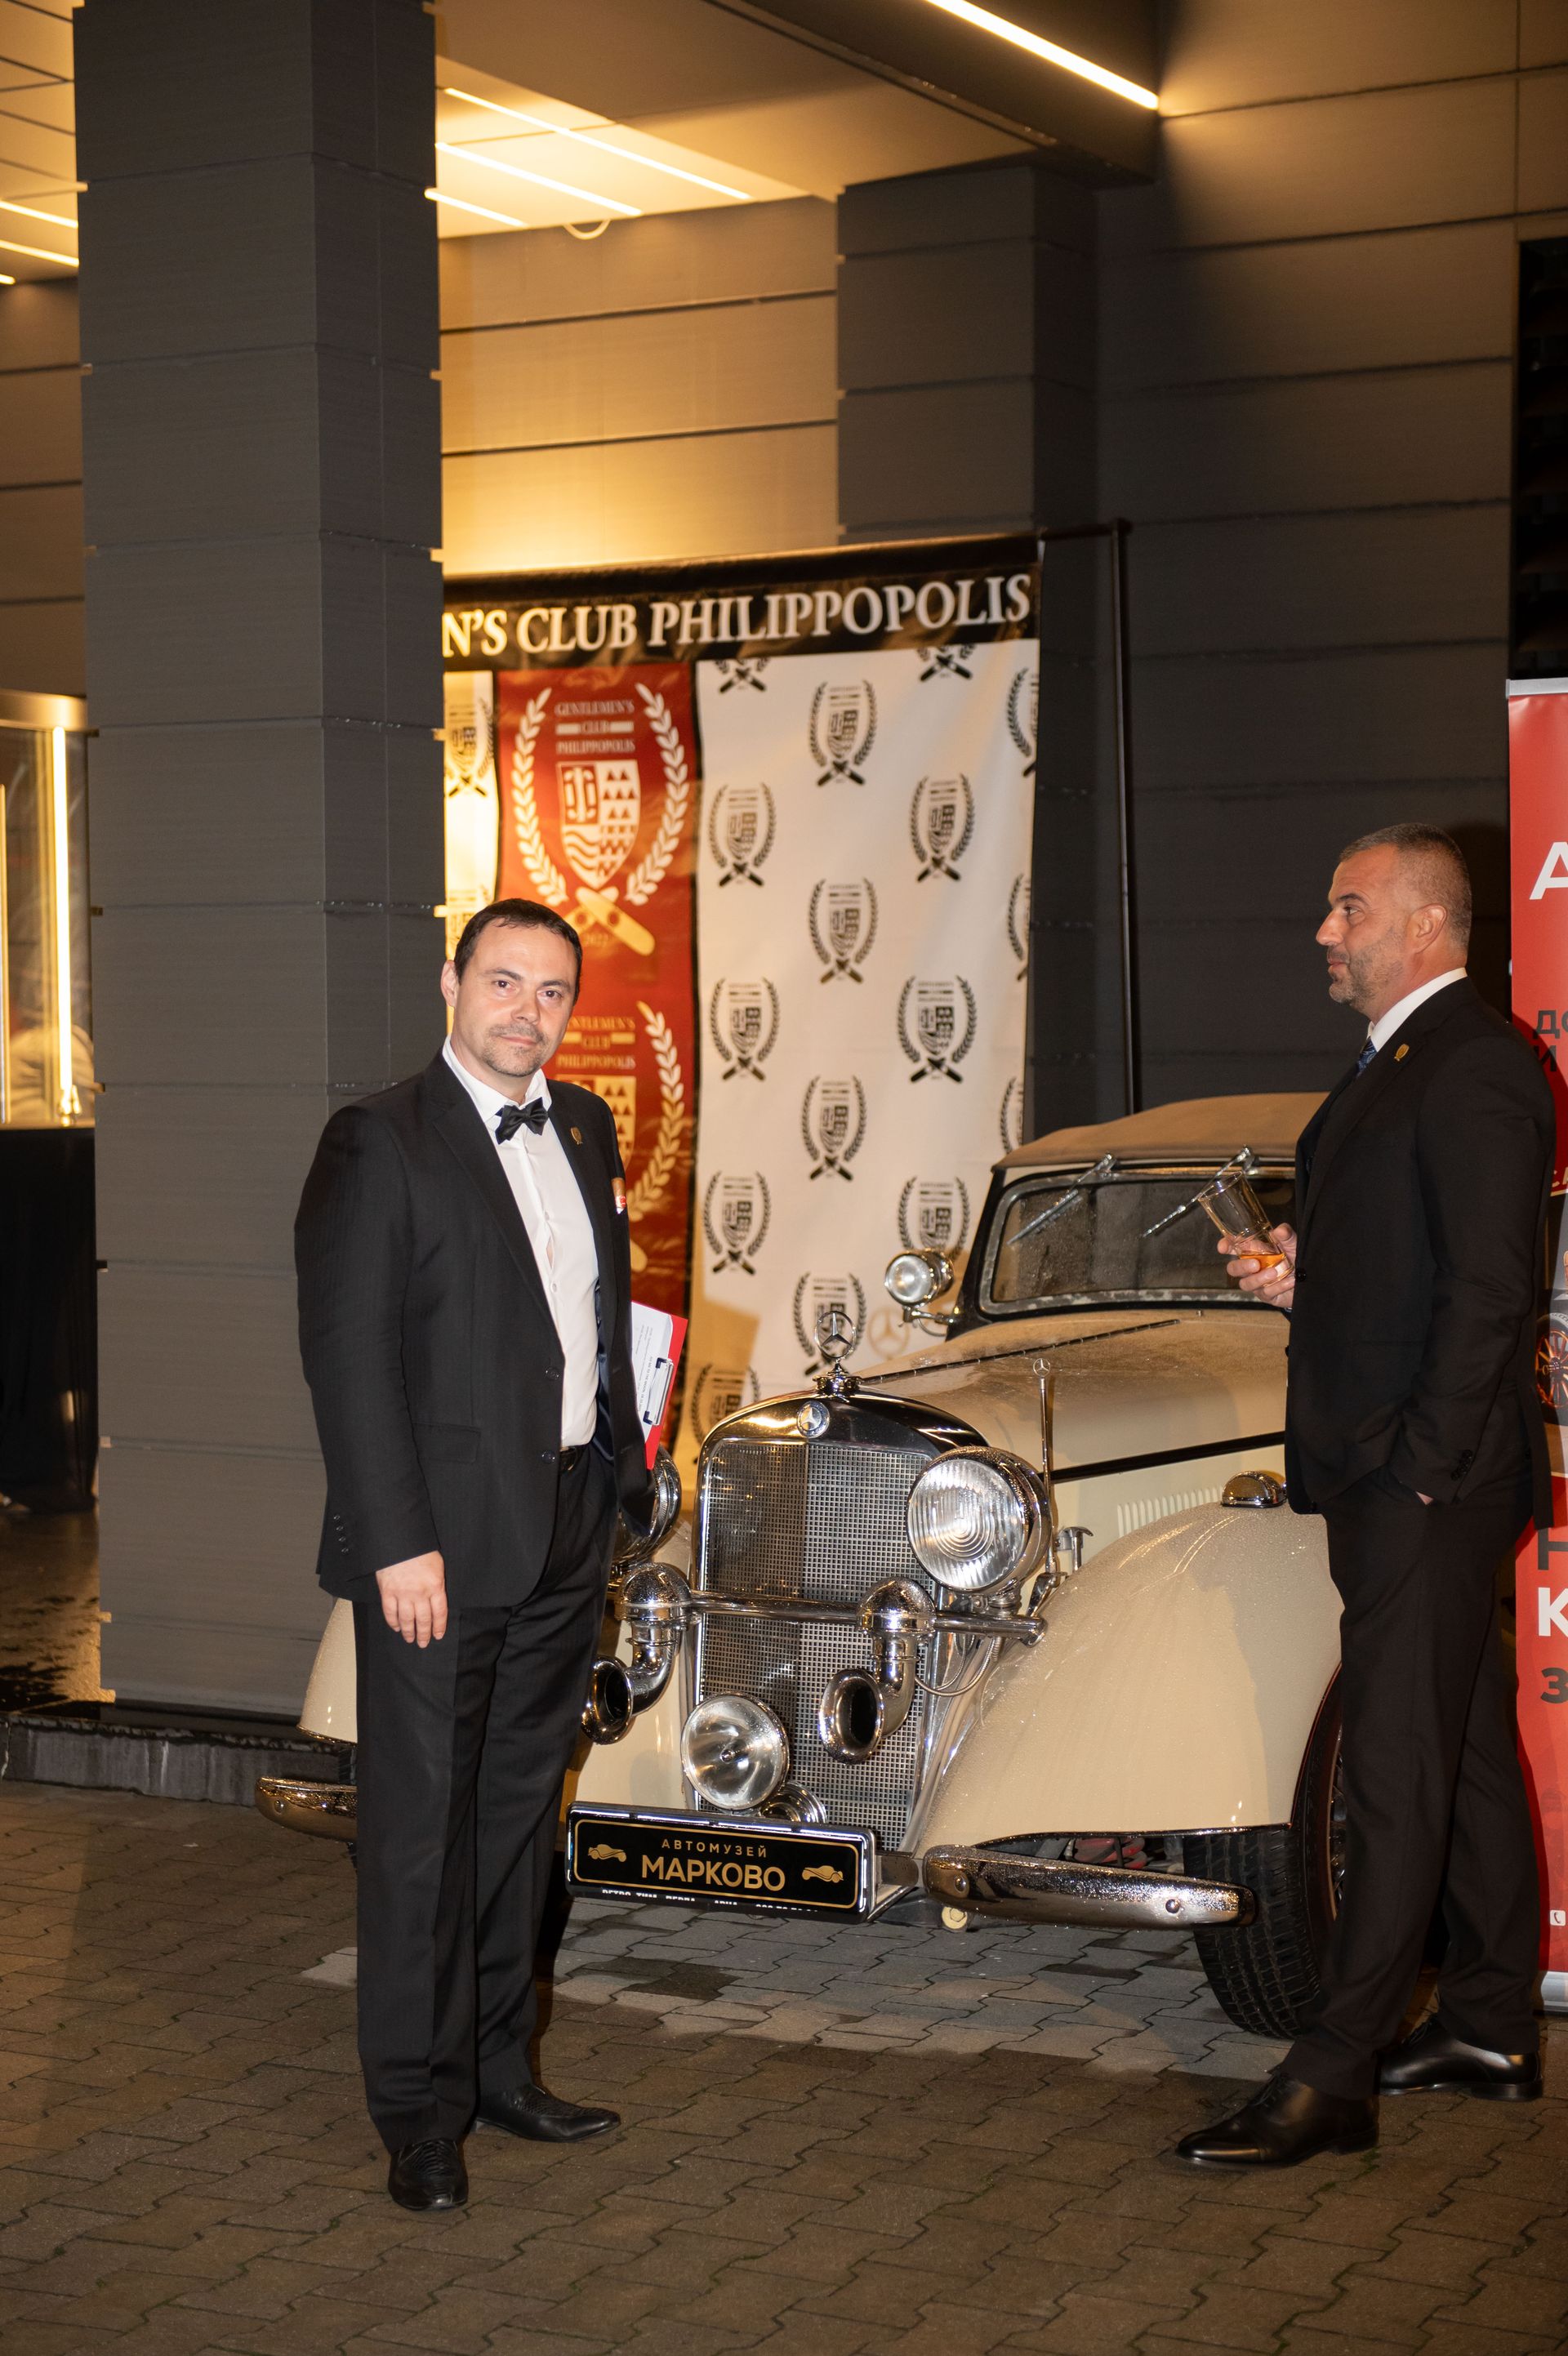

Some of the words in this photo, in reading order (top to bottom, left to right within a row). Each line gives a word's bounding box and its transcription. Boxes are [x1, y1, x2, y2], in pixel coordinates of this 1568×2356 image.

[517, 603, 638, 653] CLUB
[647, 573, 1031, 647] PHILIPPOPOLIS
[581, 720, 610, 735] CLUB
[662, 1838, 767, 1858] АВТОМУЗЕЙ
[642, 1855, 786, 1891] МАРКОВО
